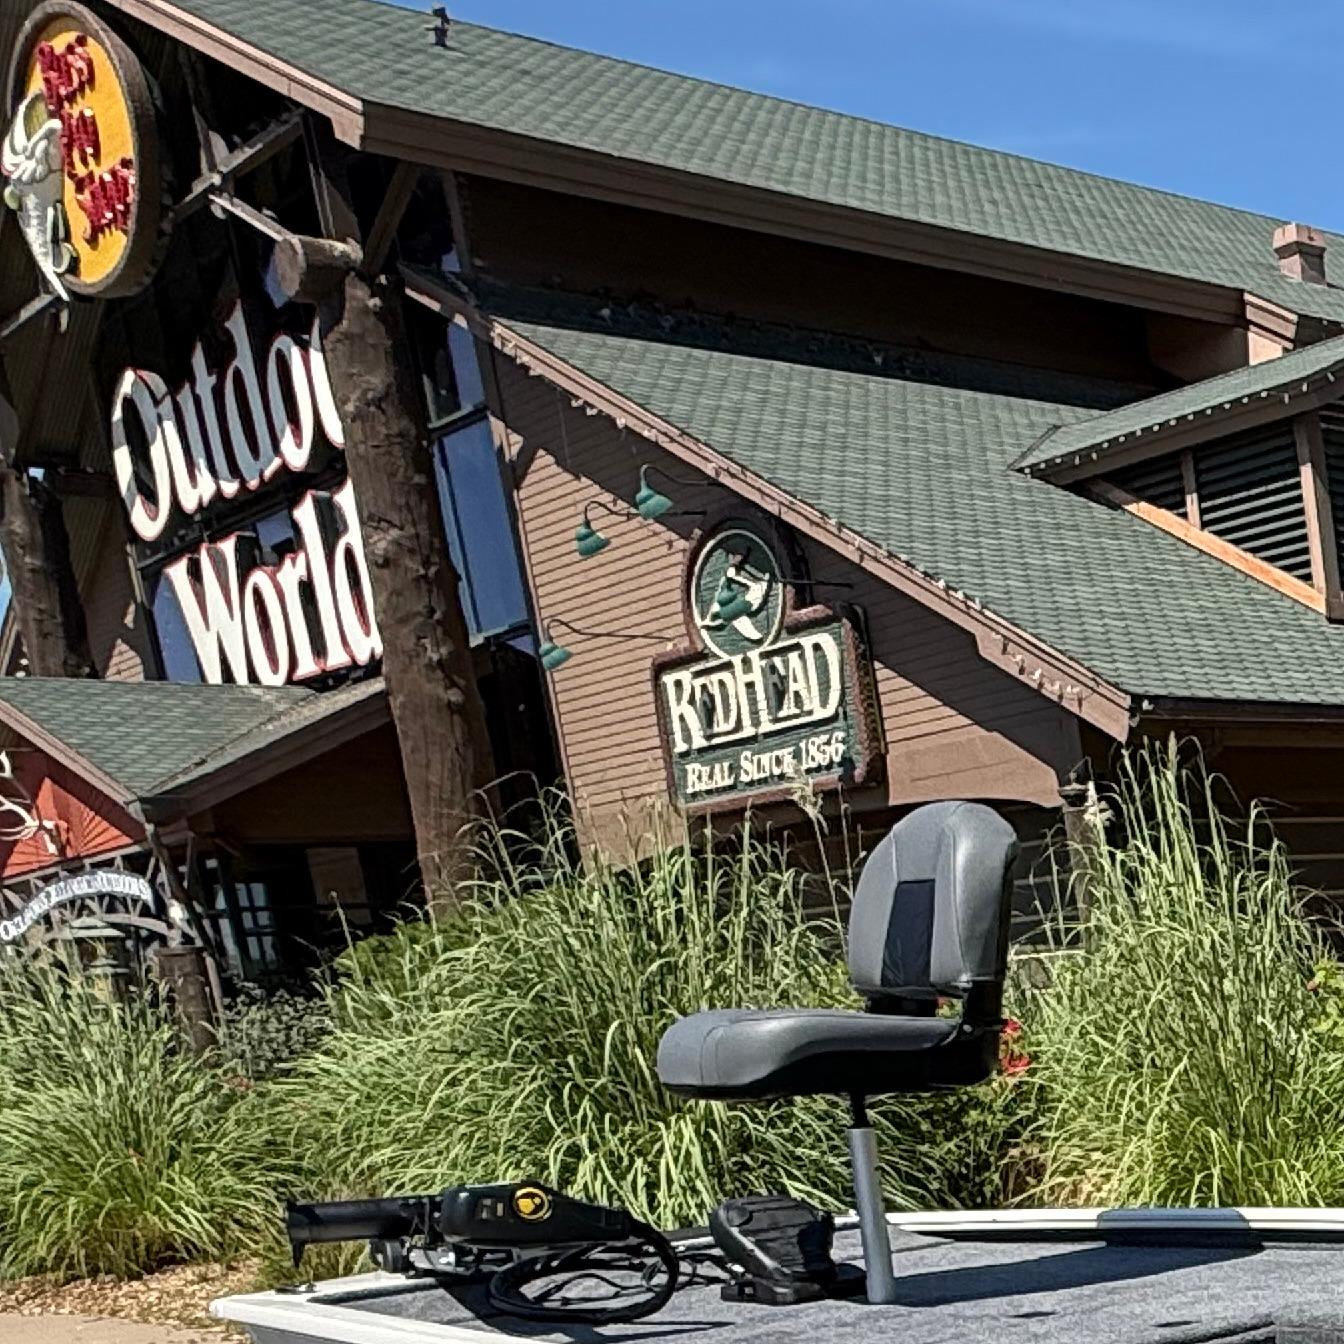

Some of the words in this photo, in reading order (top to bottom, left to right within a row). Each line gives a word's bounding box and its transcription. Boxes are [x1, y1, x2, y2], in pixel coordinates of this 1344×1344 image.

[112, 300, 346, 541] Outdo
[163, 477, 383, 686] World
[800, 732, 845, 769] 1856
